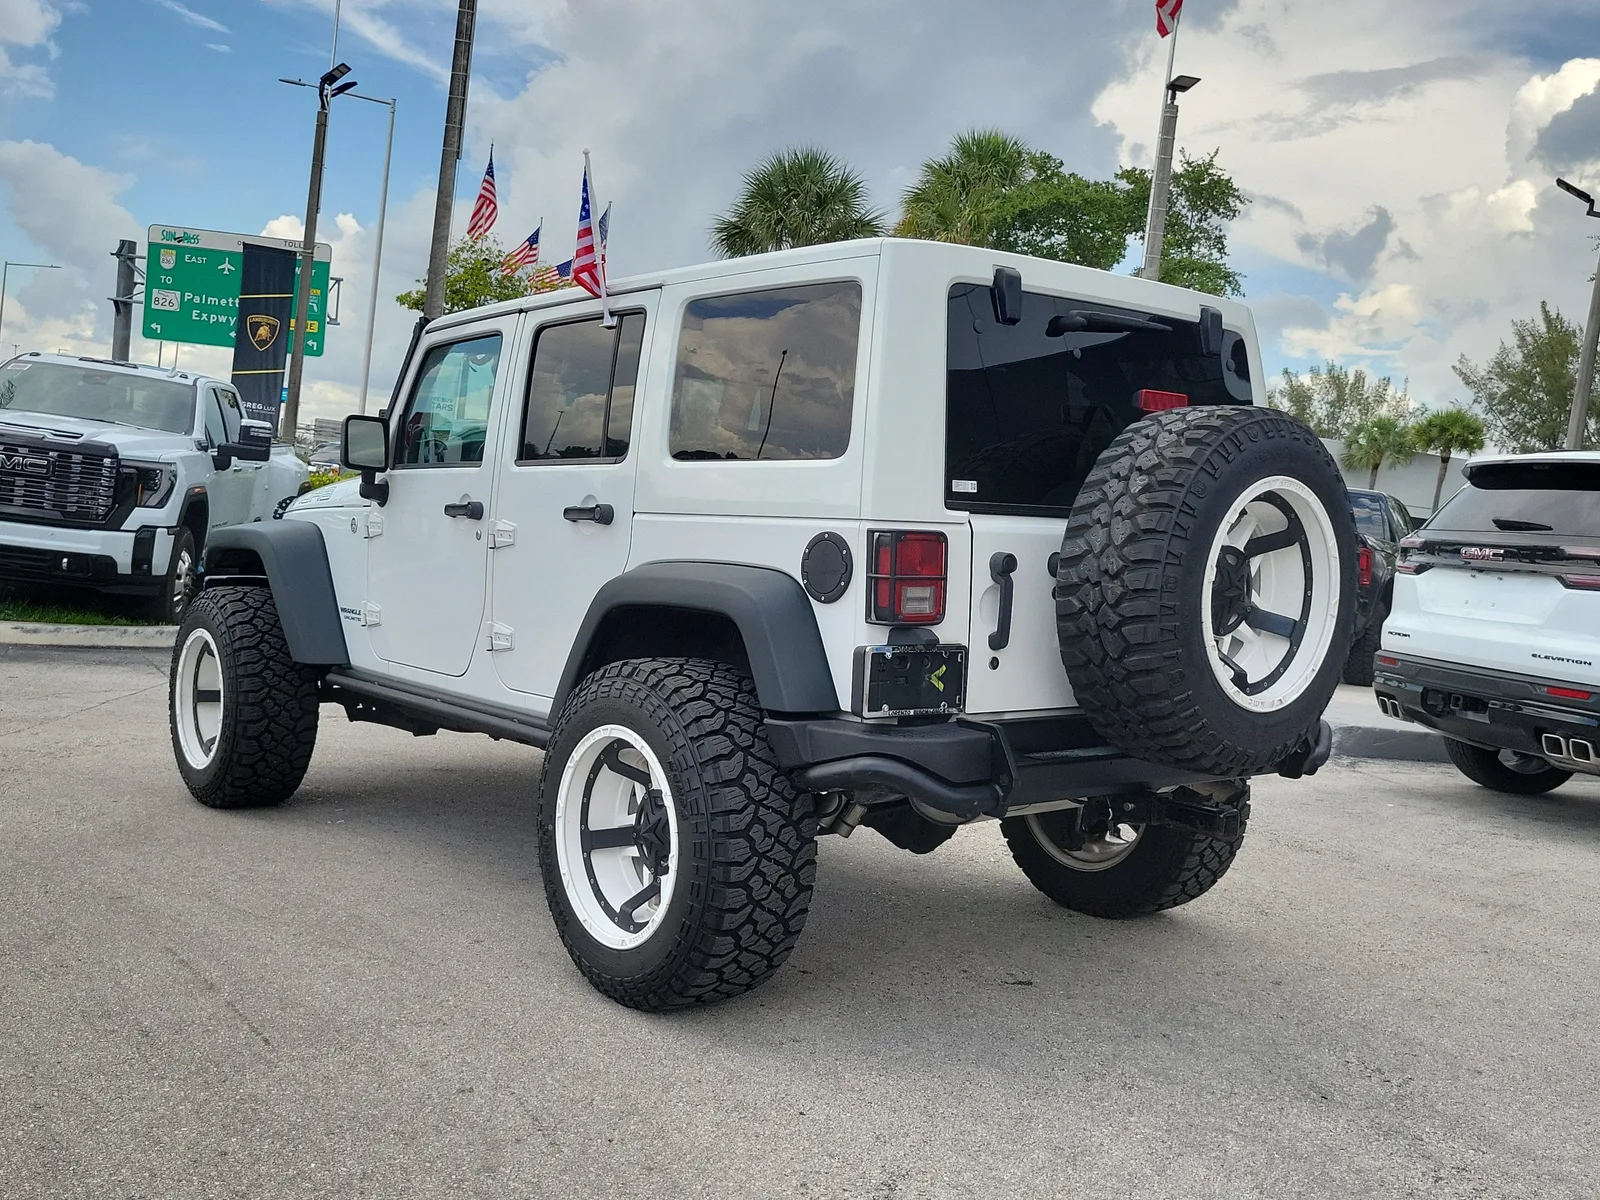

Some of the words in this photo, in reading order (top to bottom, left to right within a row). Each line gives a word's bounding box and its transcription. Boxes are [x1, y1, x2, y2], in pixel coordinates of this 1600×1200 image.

[184, 254, 207, 264] EAST
[160, 275, 173, 284] TO
[153, 296, 175, 307] 826
[184, 292, 239, 308] Palmett
[192, 309, 237, 327] Expwy
[0, 454, 48, 473] MC
[1460, 546, 1505, 562] GMC
[1531, 653, 1592, 666] ELEVATION
